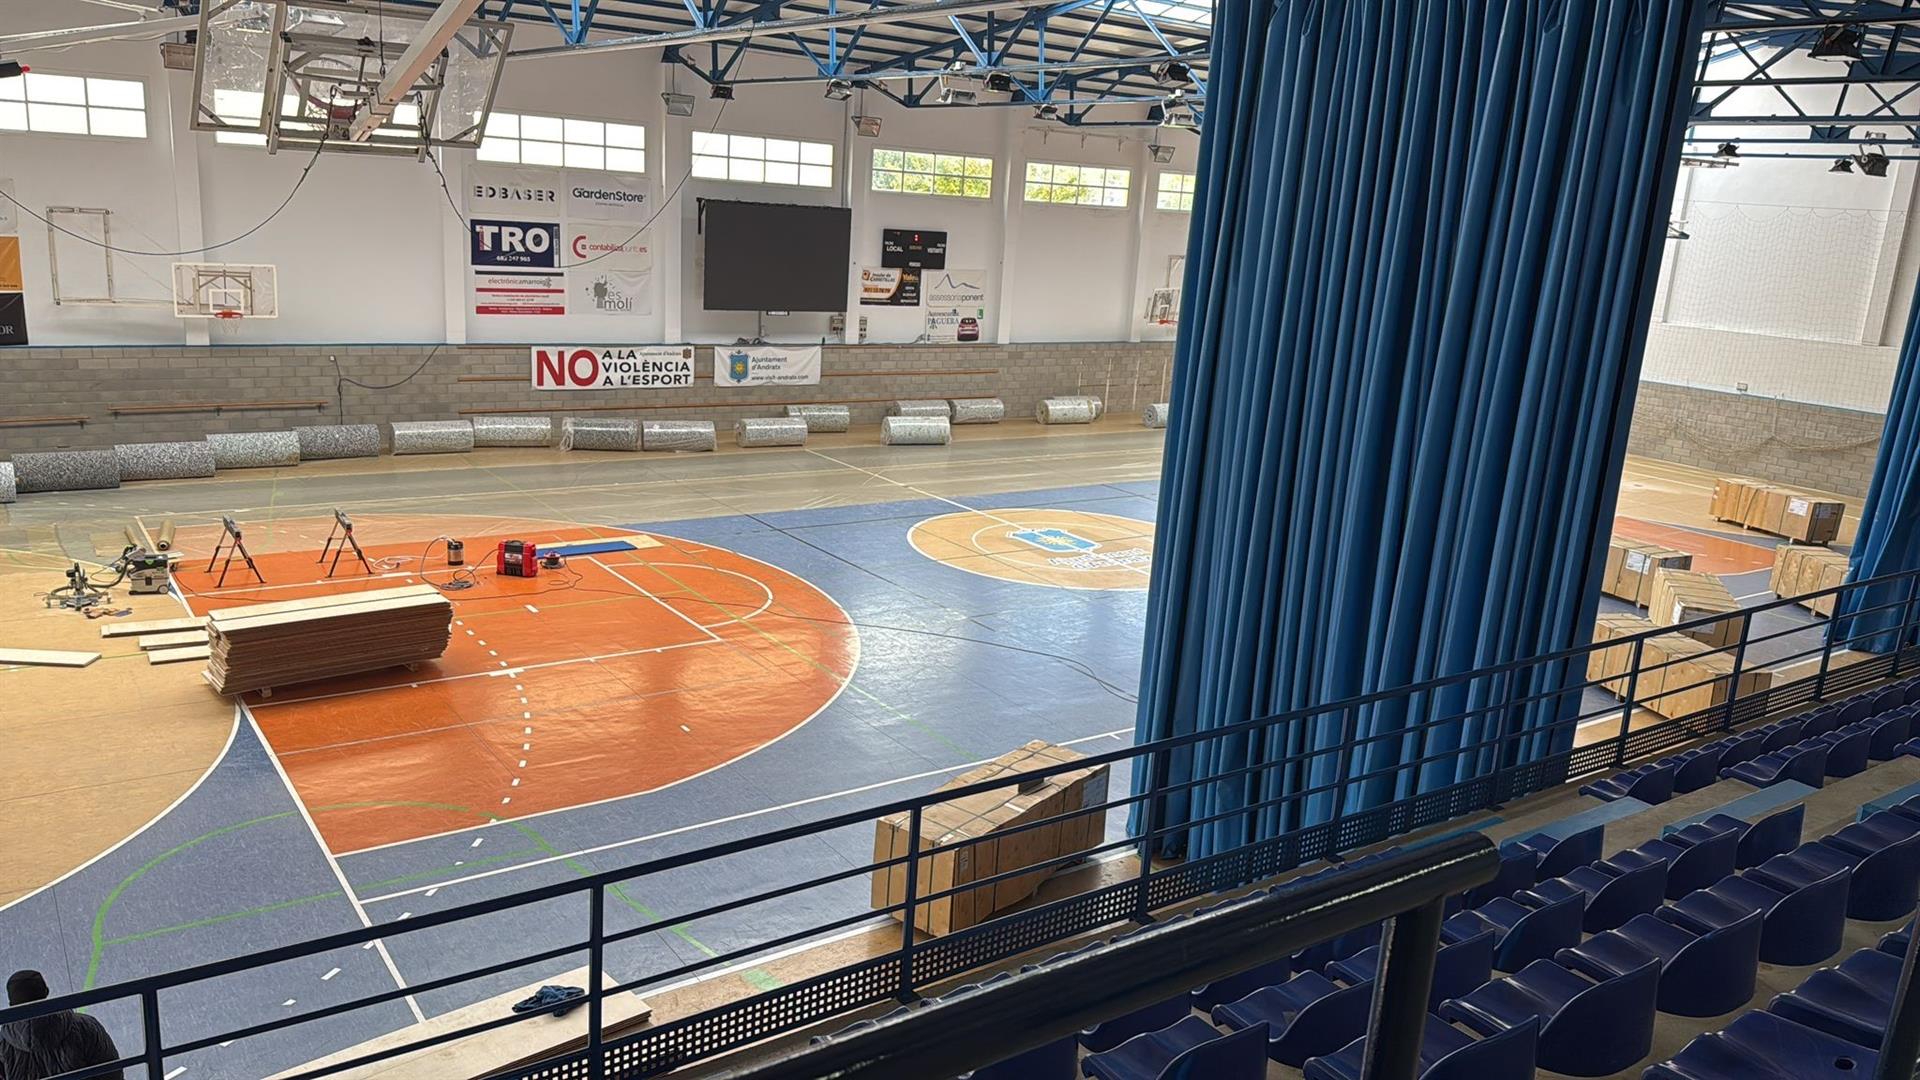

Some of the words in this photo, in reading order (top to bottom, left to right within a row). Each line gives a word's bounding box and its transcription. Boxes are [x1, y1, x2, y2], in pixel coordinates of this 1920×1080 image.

[474, 186, 555, 202] EDBASER
[572, 188, 644, 202] GardenStore
[475, 224, 550, 254] TRO
[608, 291, 622, 300] es
[604, 298, 632, 310] molí
[602, 350, 614, 360] A
[617, 350, 637, 360] LA
[536, 350, 600, 386] NO
[603, 359, 690, 373] VIOLÈNCIA
[602, 376, 614, 386] A
[620, 374, 690, 386] L'ESPORT
